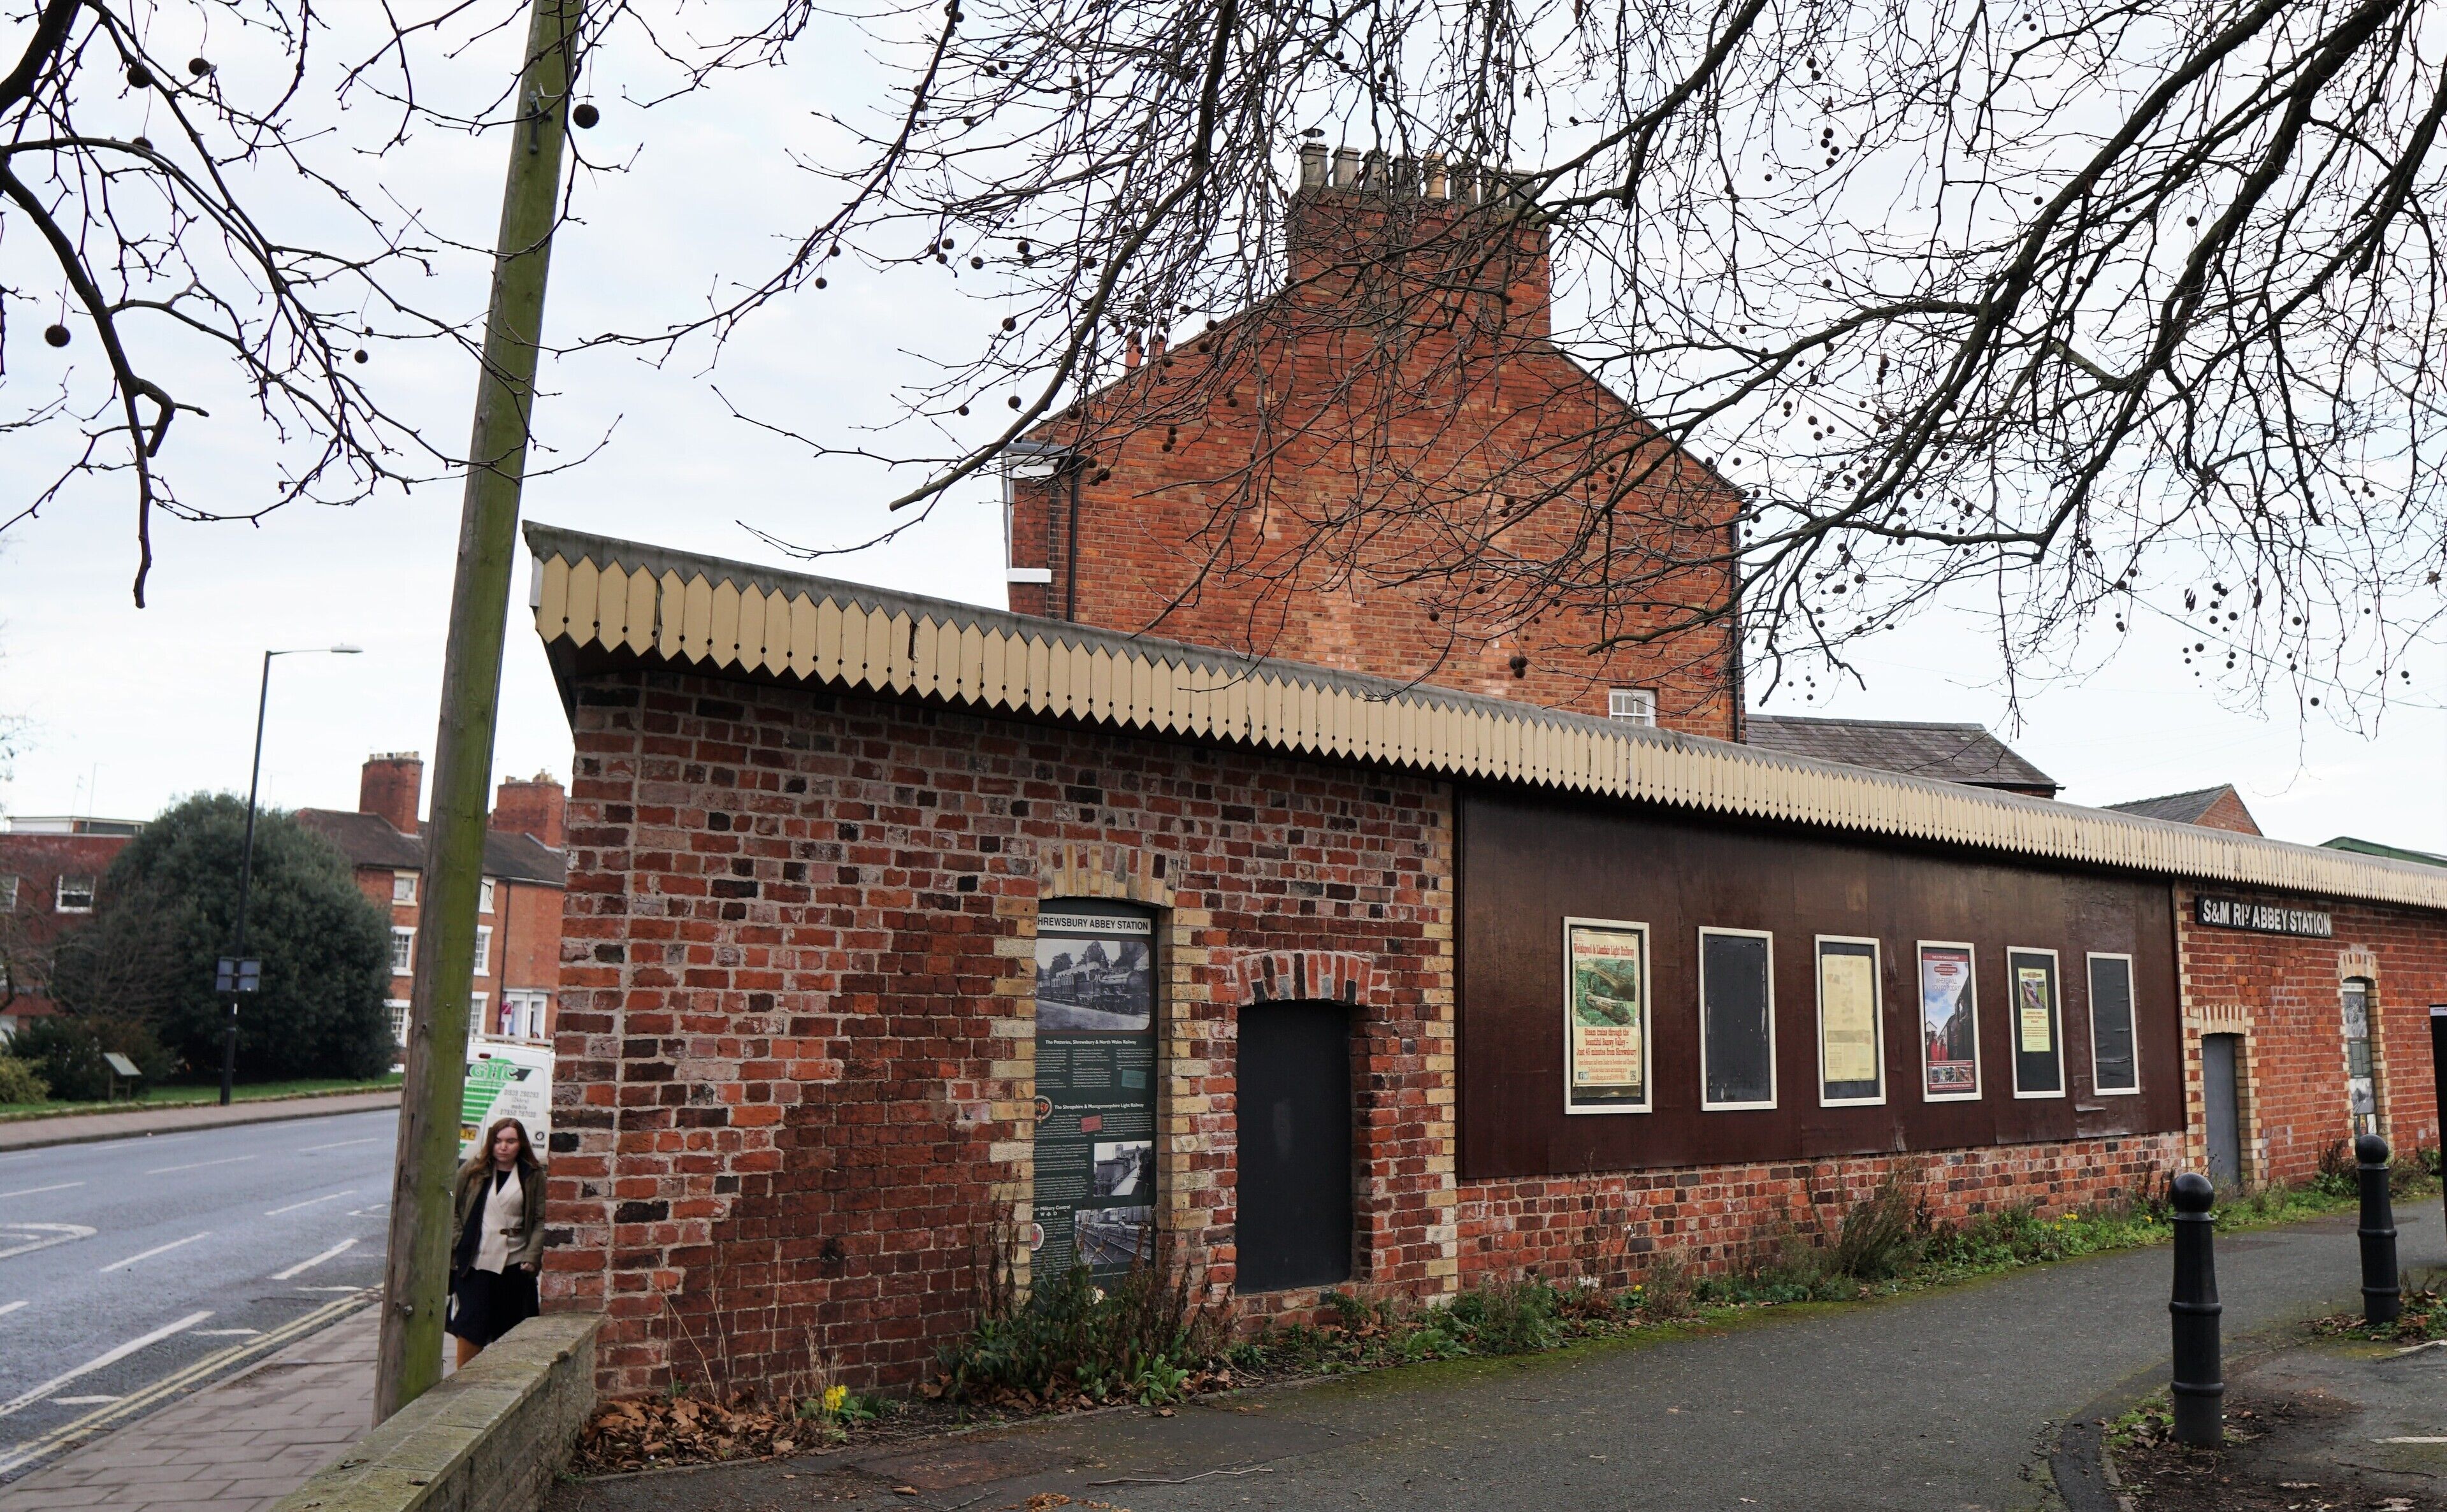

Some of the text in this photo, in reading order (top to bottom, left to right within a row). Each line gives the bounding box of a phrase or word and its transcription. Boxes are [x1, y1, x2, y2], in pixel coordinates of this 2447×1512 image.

[1037, 916, 1148, 930] HREWSBURY ABBEY STATION
[2203, 899, 2229, 925] S&M
[2252, 905, 2288, 931] ABBEY
[2290, 911, 2332, 935] STATION
[469, 1063, 519, 1081] GHC
